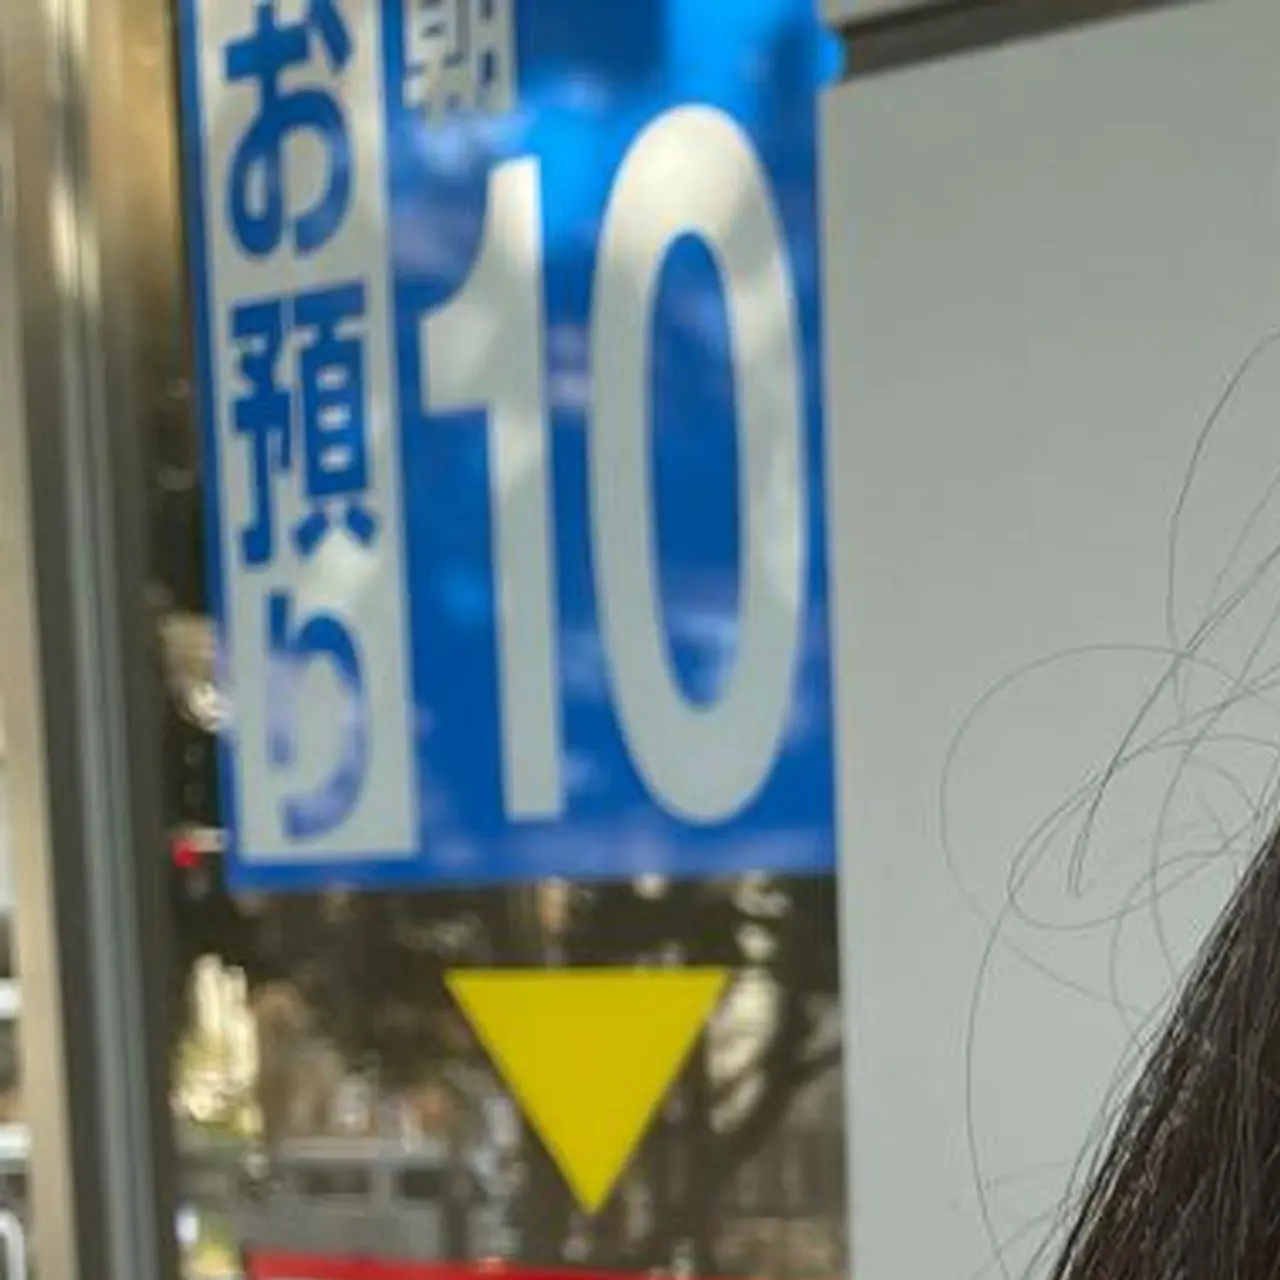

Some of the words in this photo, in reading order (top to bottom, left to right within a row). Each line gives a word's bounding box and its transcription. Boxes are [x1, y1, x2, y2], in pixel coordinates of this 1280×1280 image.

[224, 0, 382, 839] お預り
[419, 104, 805, 823] 10
